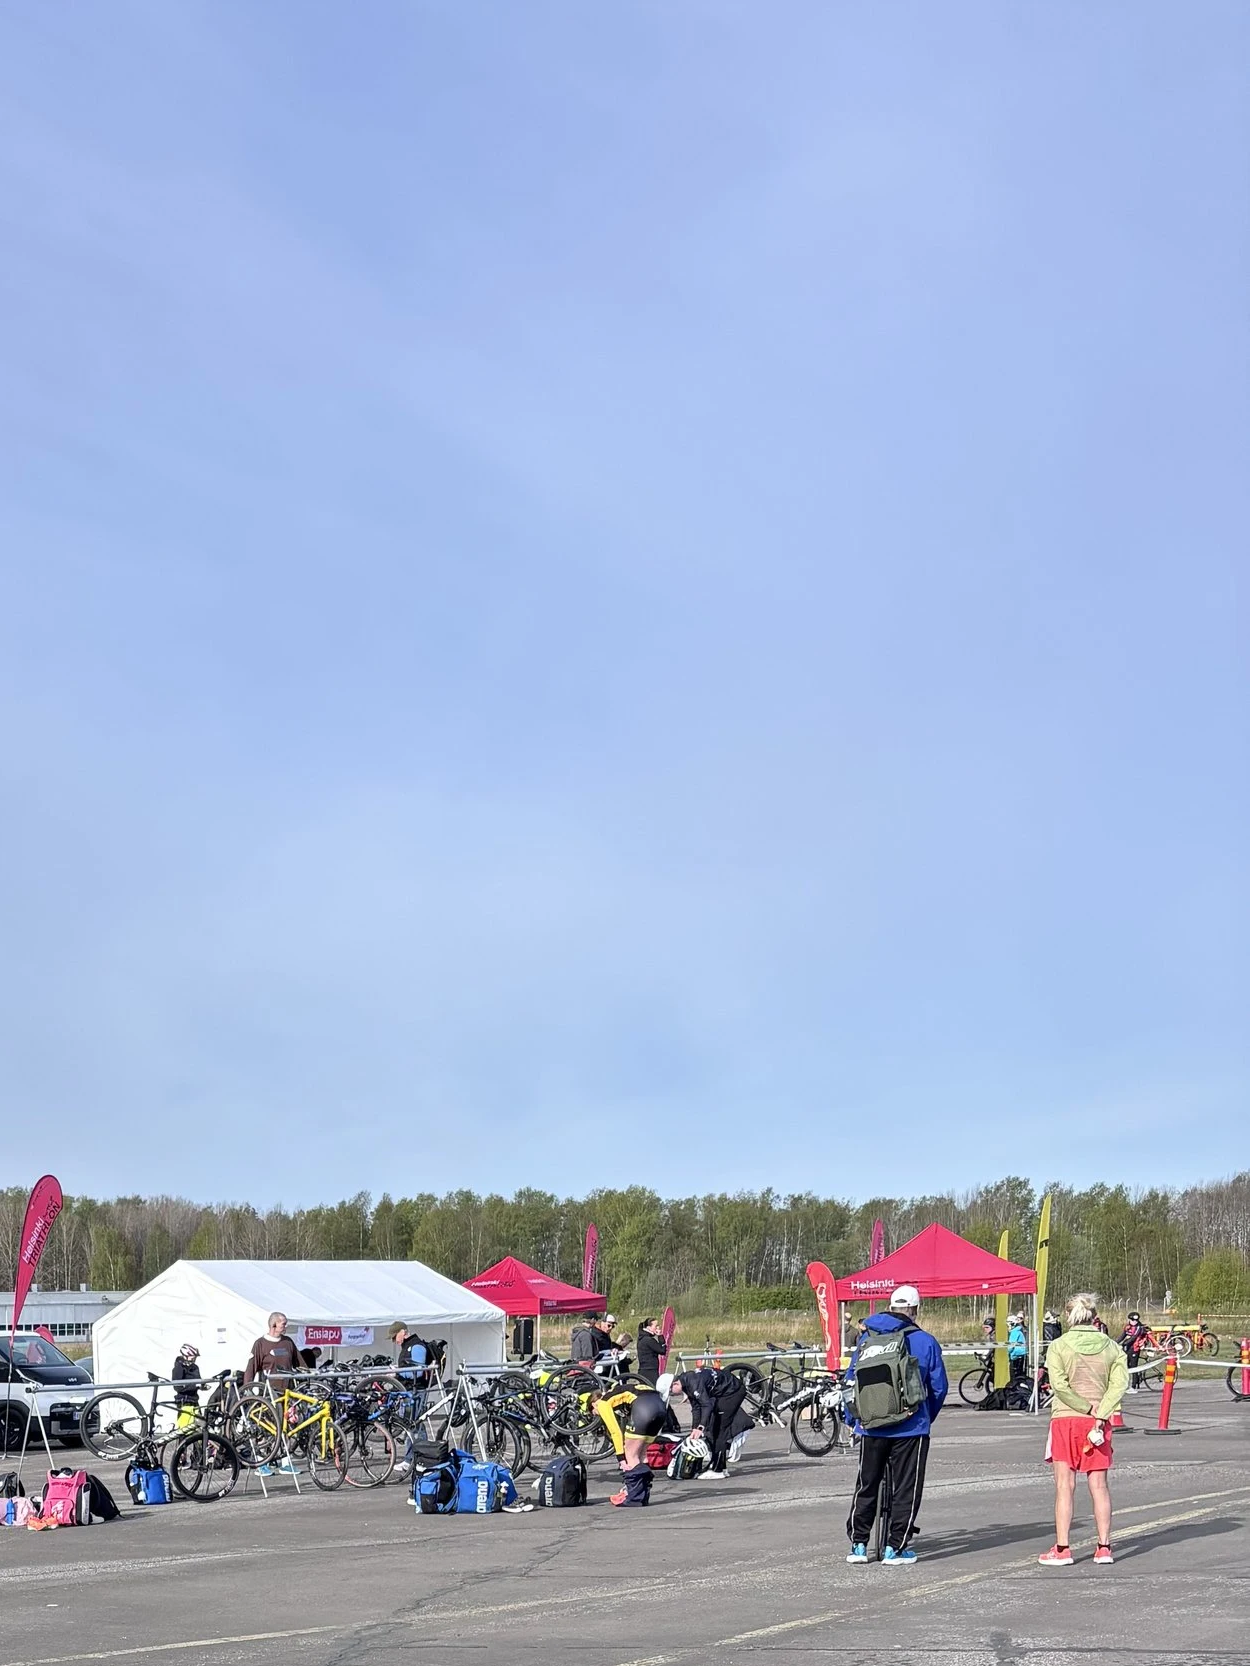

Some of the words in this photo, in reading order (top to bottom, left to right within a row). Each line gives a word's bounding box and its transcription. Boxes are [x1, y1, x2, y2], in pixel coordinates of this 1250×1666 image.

[22, 1216, 45, 1264] Helsinki
[28, 1201, 61, 1268] TRIATHLON
[851, 1279, 895, 1290] Helsinki
[307, 1327, 340, 1341] Ensiapu
[476, 1480, 488, 1514] arena
